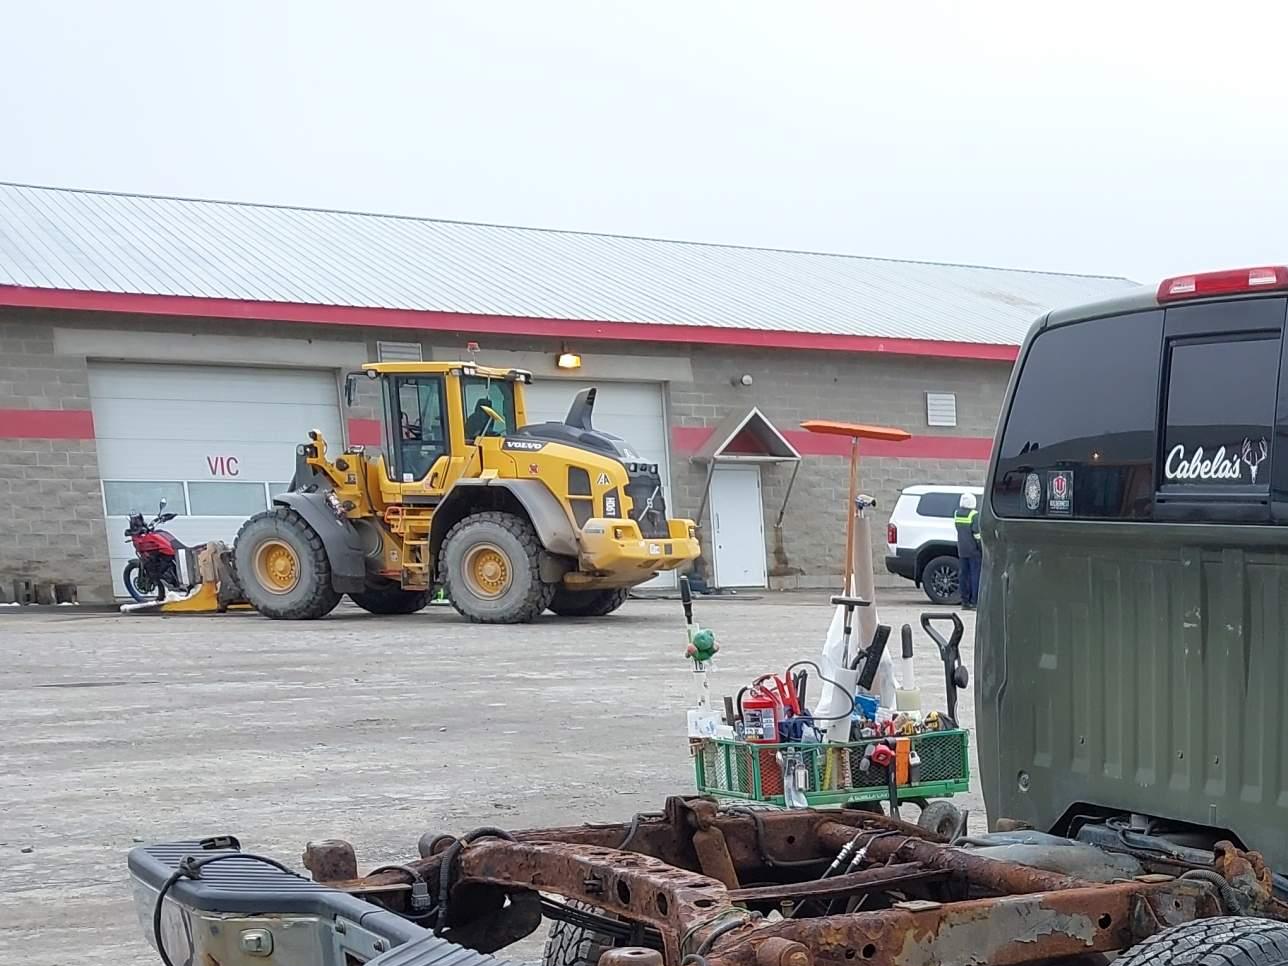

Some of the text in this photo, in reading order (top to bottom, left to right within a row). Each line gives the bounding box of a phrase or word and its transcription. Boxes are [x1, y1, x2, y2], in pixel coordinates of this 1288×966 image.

[507, 441, 542, 449] VOLVO
[206, 455, 239, 476] VIC
[1165, 444, 1241, 478] Cabela's
